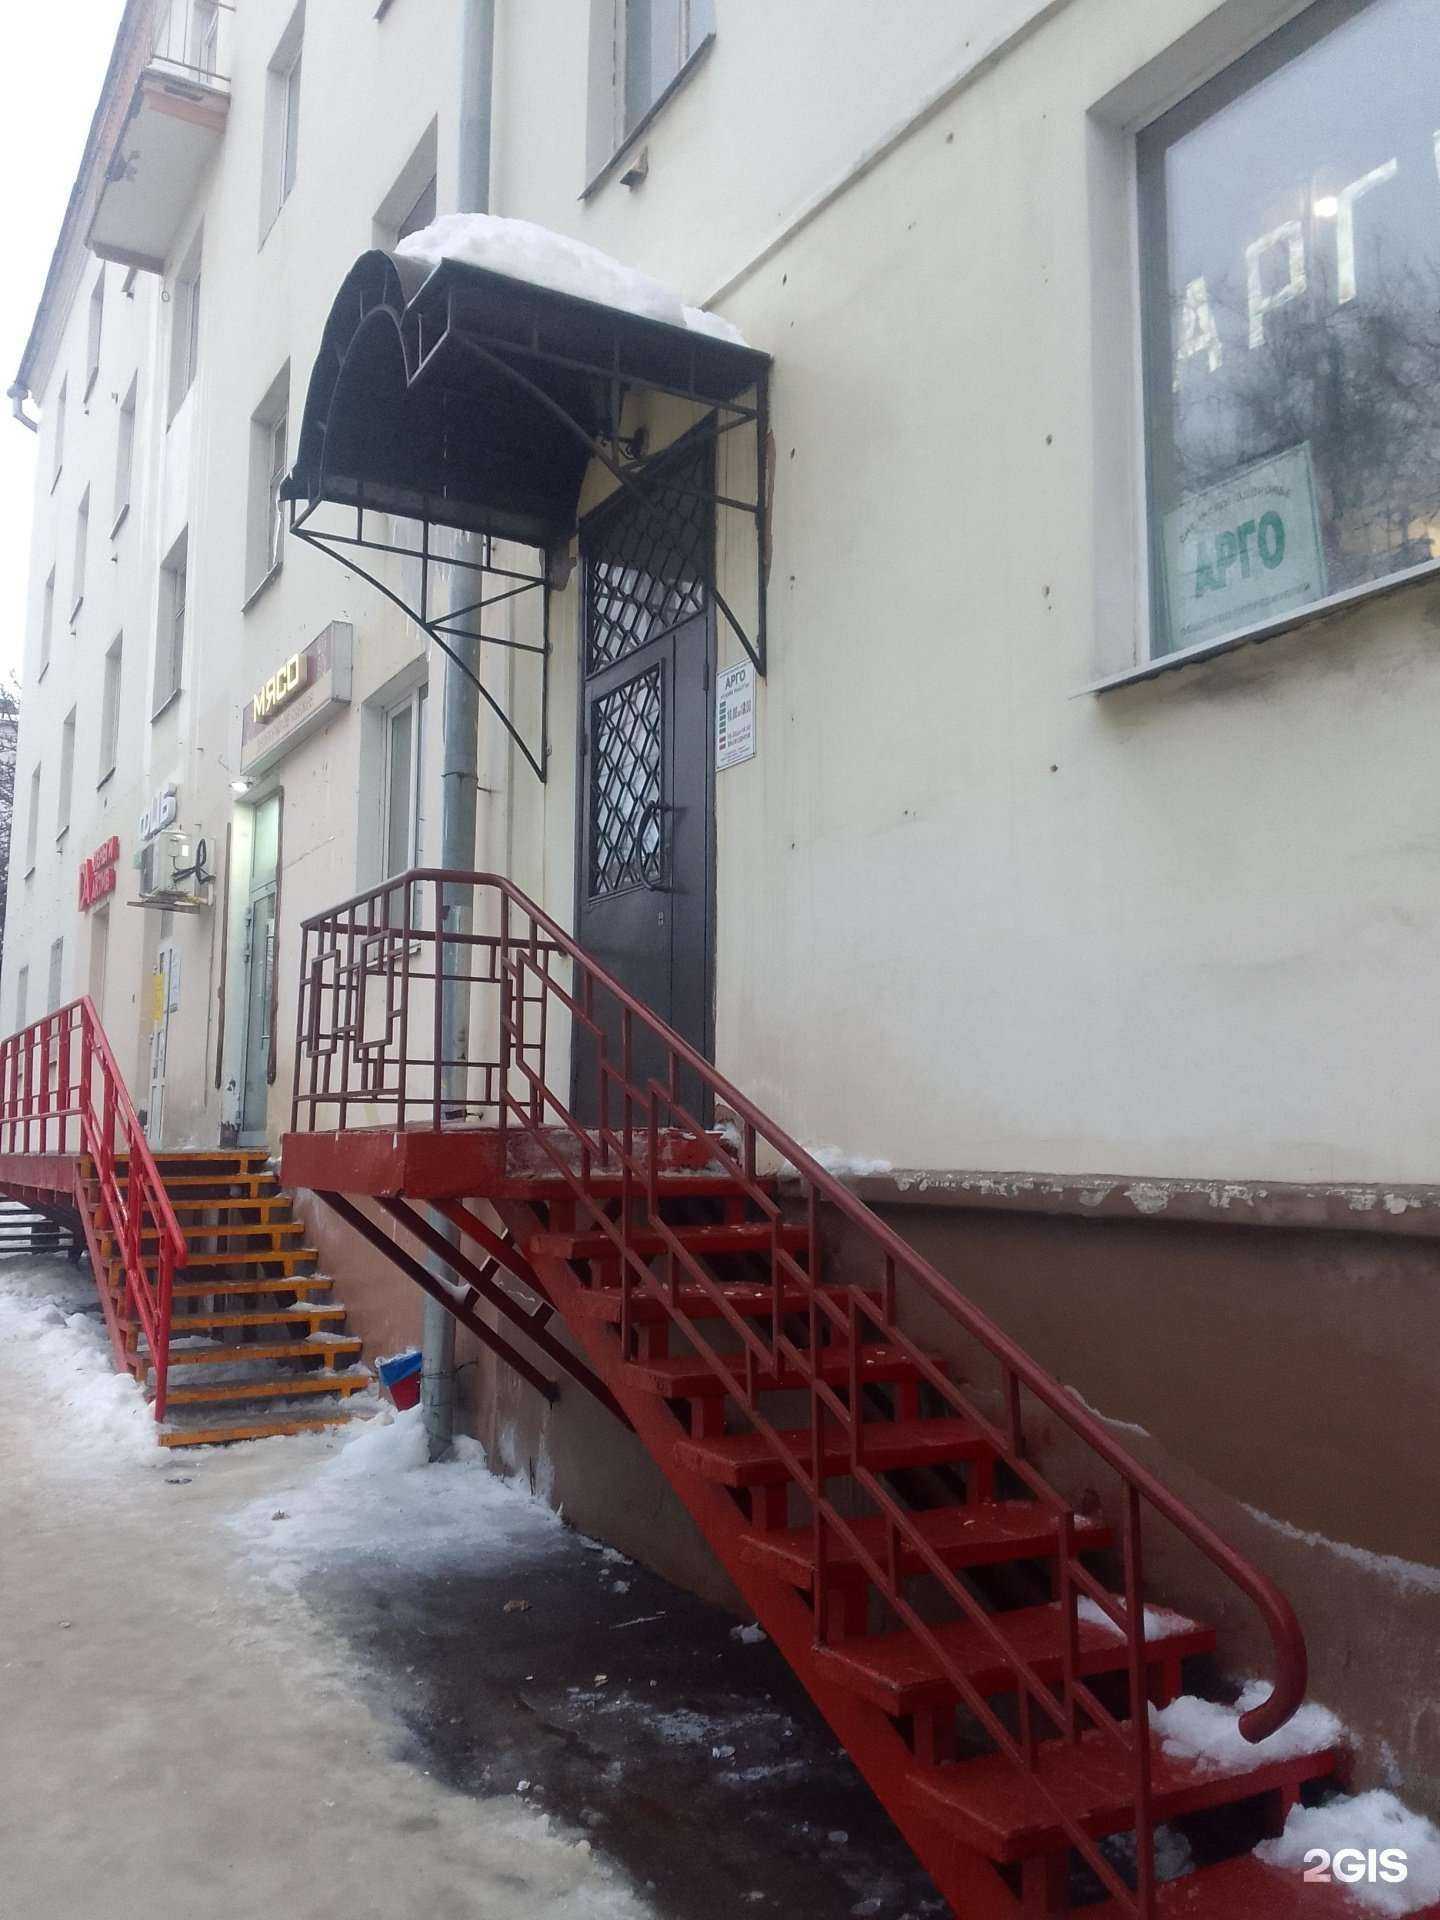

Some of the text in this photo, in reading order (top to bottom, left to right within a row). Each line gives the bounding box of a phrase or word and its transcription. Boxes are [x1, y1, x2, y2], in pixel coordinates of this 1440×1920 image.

[1172, 128, 1440, 393] АРГ
[1195, 510, 1286, 598] АРГО
[253, 653, 300, 723] МЯСО
[725, 669, 746, 690] АРГО
